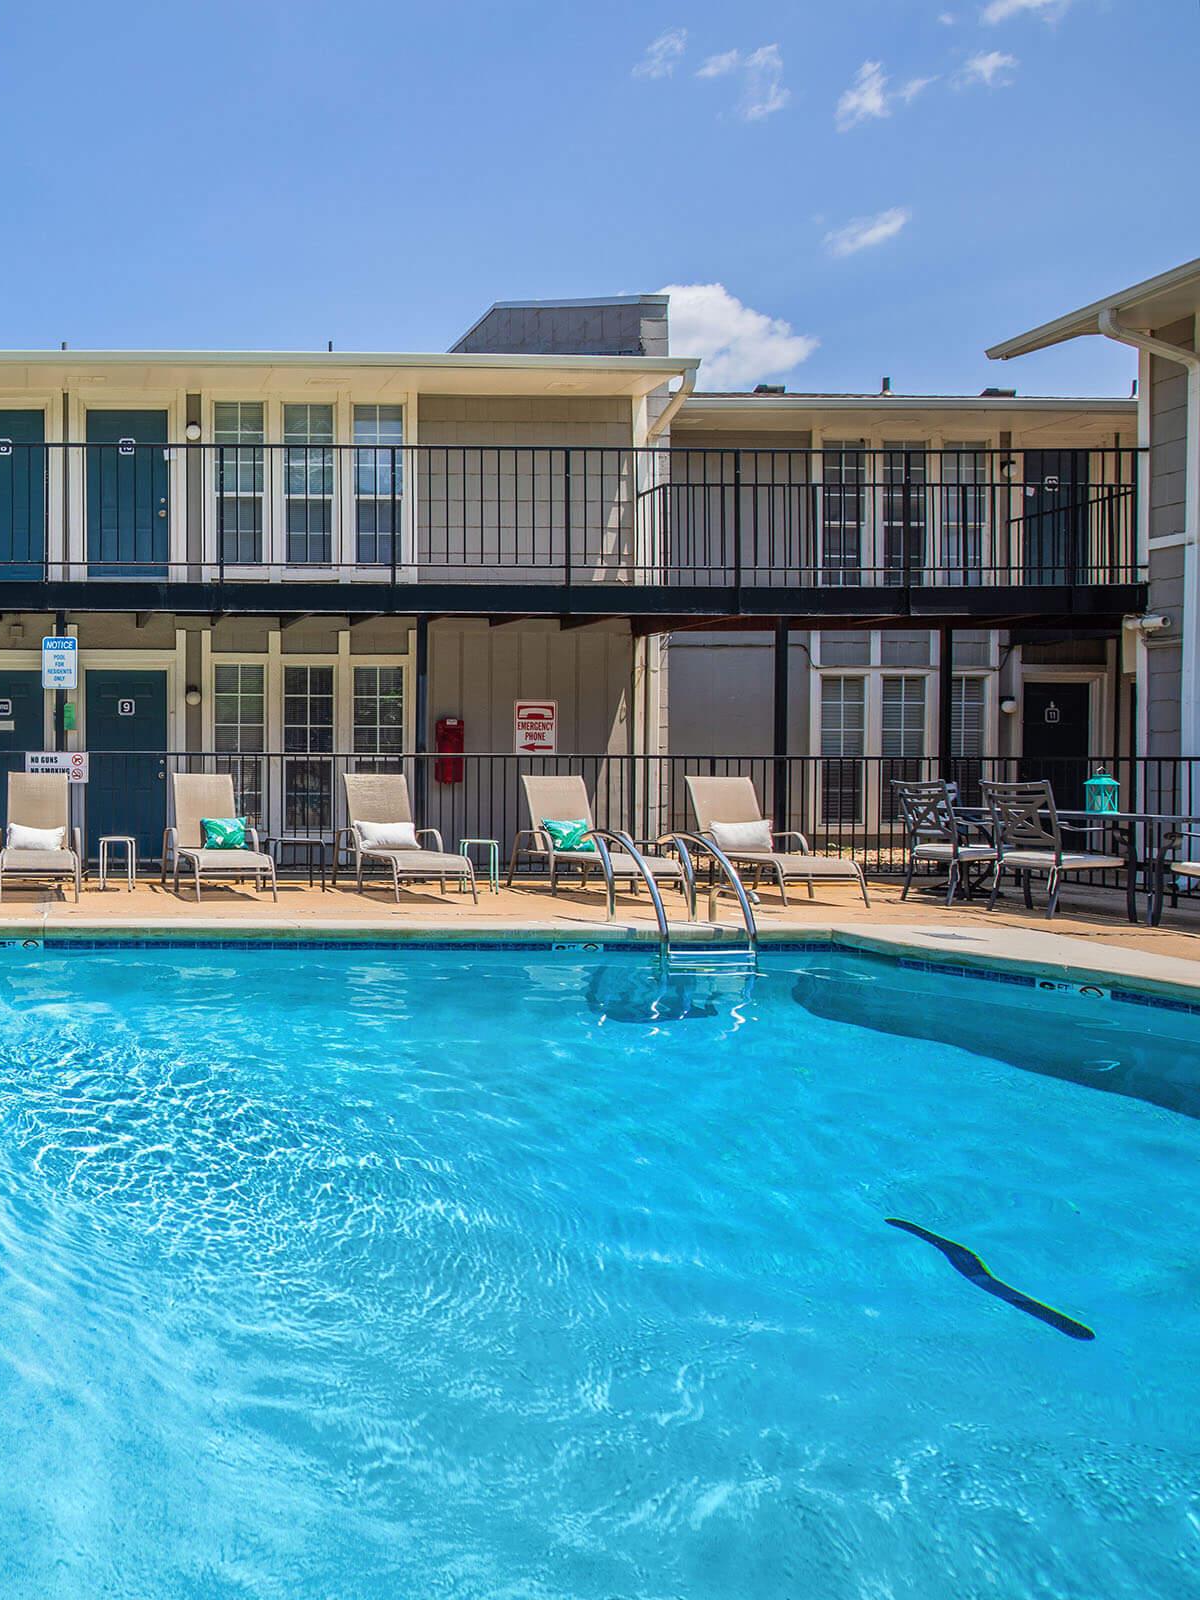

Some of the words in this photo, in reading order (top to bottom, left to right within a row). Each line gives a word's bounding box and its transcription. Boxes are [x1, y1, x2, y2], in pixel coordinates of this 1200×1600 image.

[46, 640, 73, 649] NOTICE
[123, 702, 130, 712] 9
[518, 722, 554, 730] EMERGENCY
[525, 732, 546, 740] PHONE
[30, 756, 40, 764] NO
[40, 756, 58, 764] GUNS
